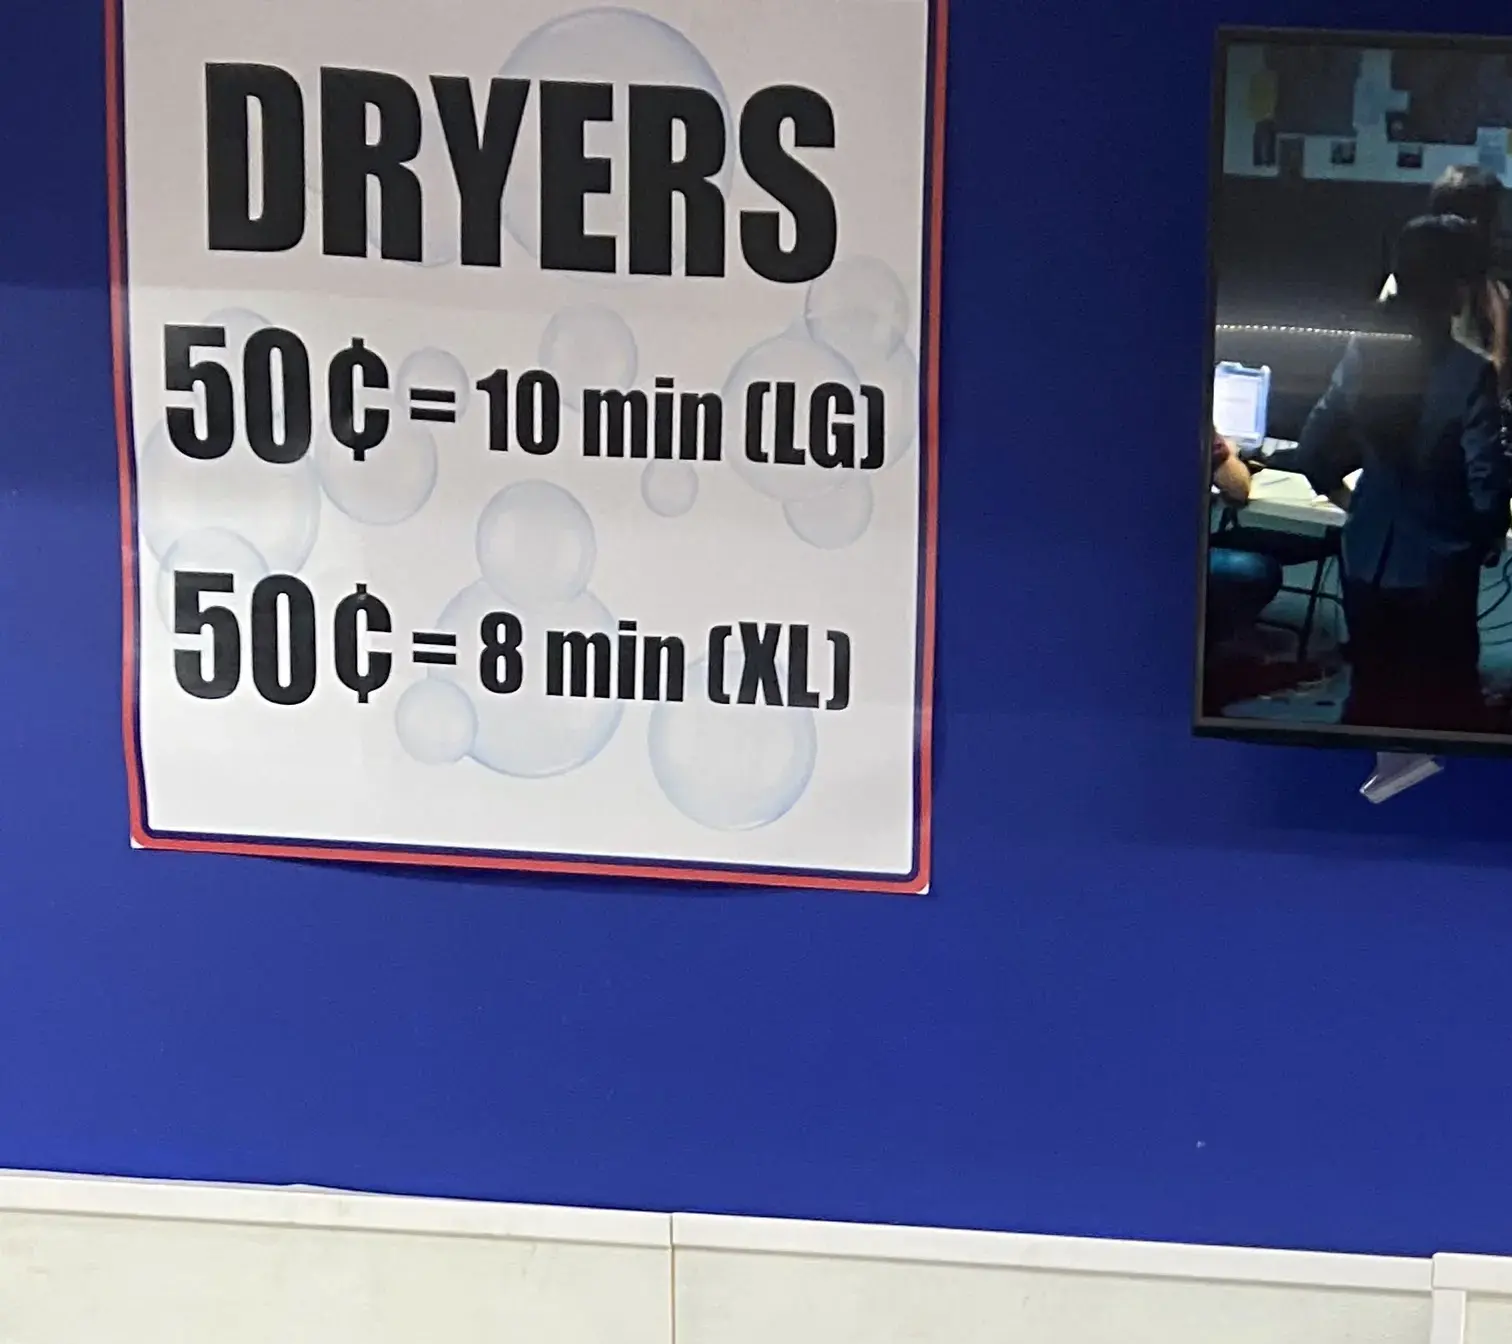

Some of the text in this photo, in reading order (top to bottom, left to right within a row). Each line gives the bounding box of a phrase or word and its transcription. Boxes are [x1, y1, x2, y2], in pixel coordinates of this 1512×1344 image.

[204, 61, 838, 284] DRYERS
[163, 324, 390, 464] 50¢
[476, 368, 560, 456] 10
[581, 378, 723, 461] min
[744, 380, 885, 470] (LG)
[171, 571, 393, 706] 50¢
[479, 611, 524, 695] 8
[545, 621, 685, 702] min
[708, 622, 850, 712] (XL)
